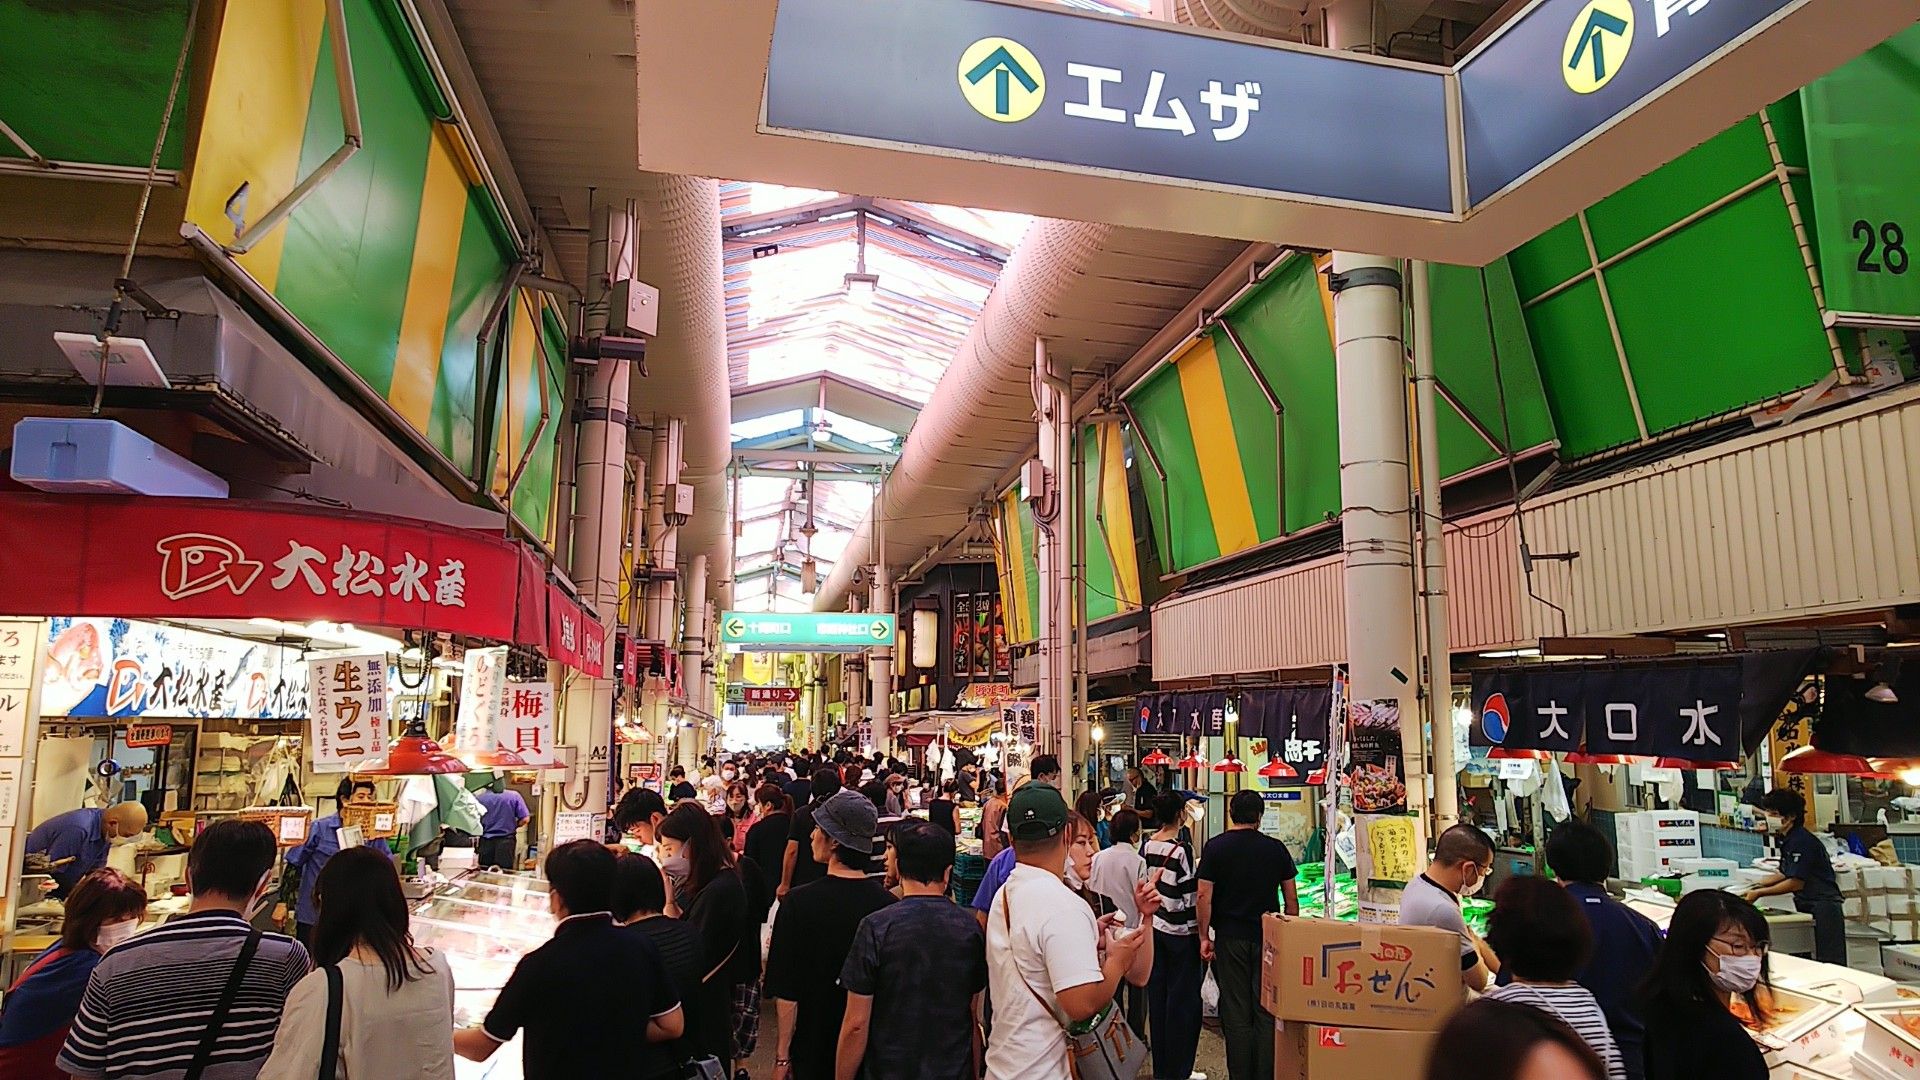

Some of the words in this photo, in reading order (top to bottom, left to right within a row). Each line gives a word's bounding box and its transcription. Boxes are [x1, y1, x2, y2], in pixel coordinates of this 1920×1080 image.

[1063, 61, 1261, 142] エムザ
[1853, 219, 1909, 274] 28
[271, 540, 466, 607] 大松水産
[333, 660, 365, 757] 生ウニ
[367, 660, 382, 712] 無添加
[751, 689, 780, 699] 新通り
[370, 716, 381, 752] 極上品
[512, 689, 543, 754] 梅貝
[591, 746, 608, 760] A2
